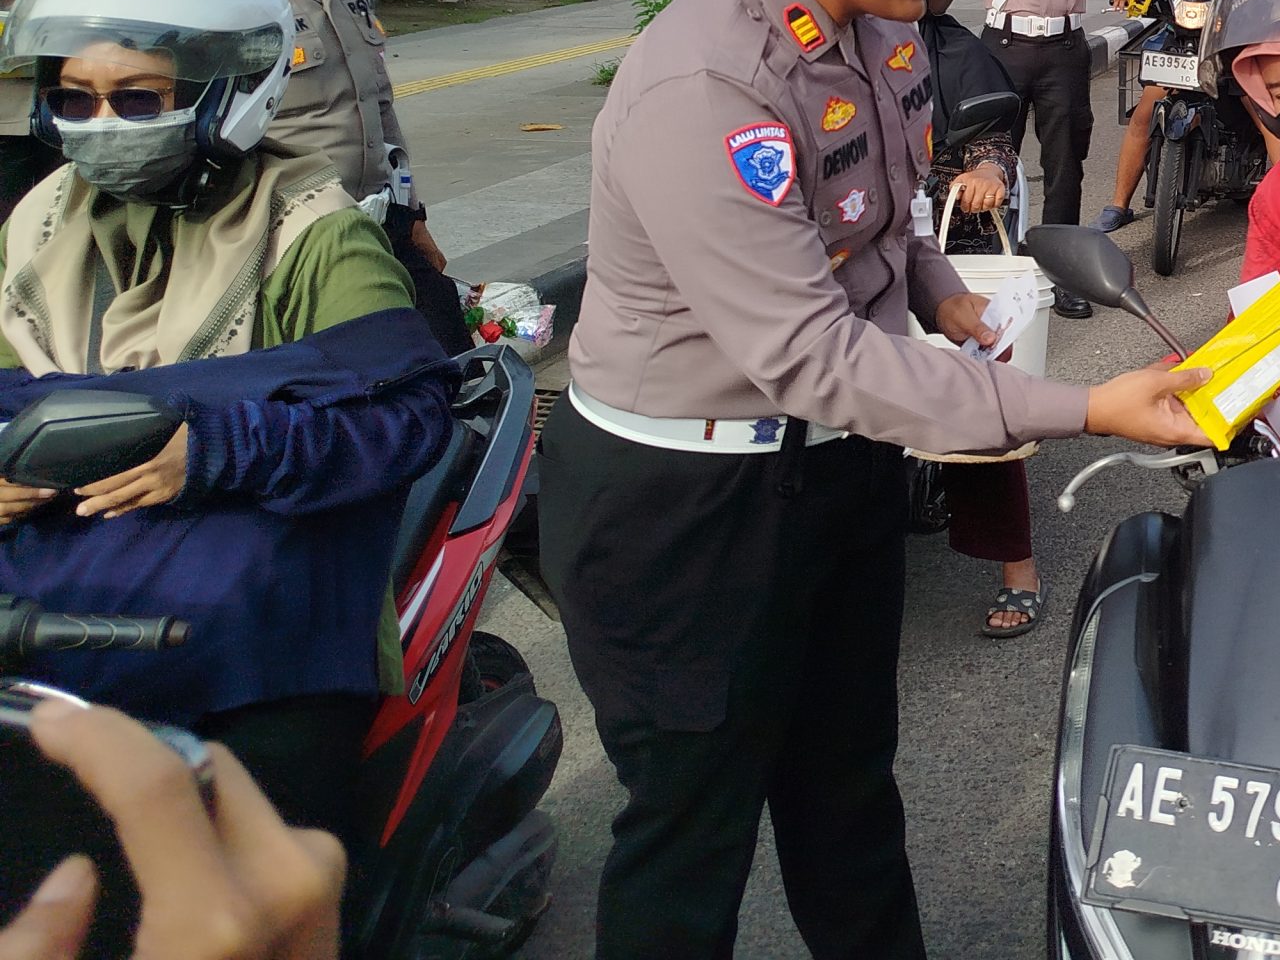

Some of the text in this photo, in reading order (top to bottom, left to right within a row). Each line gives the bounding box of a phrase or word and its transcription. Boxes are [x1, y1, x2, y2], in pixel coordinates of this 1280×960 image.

[729, 126, 786, 147] LALU LINTAS
[408, 560, 484, 706] VARIO
[1116, 762, 1183, 826] AE
